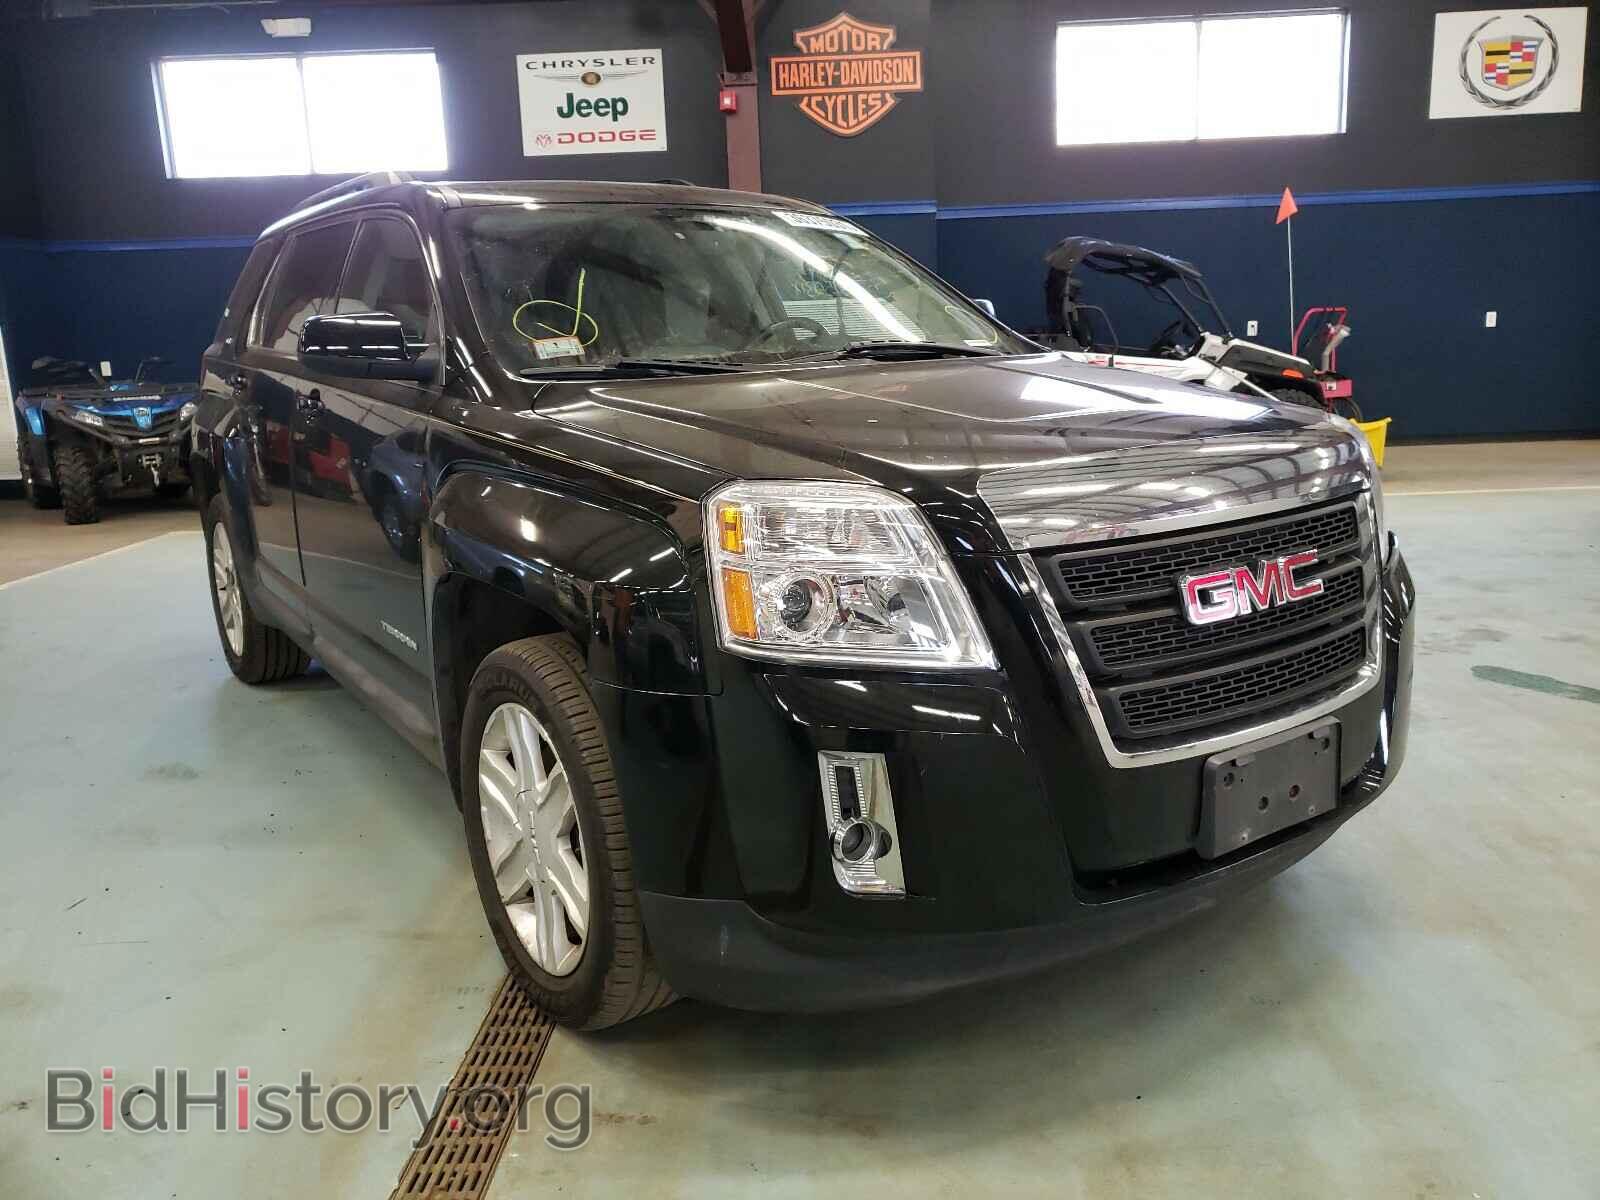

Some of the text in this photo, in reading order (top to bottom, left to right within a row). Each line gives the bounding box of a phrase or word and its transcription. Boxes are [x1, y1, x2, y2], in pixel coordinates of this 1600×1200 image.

[810, 24, 881, 53] MOTOR
[526, 56, 656, 70] CHRYSLER
[779, 57, 914, 89] HARLEY-DAVIDSON
[556, 92, 629, 122] Jeep
[810, 93, 882, 128] CYCLES
[557, 129, 657, 145] DODGE
[1179, 549, 1324, 625] GMC
